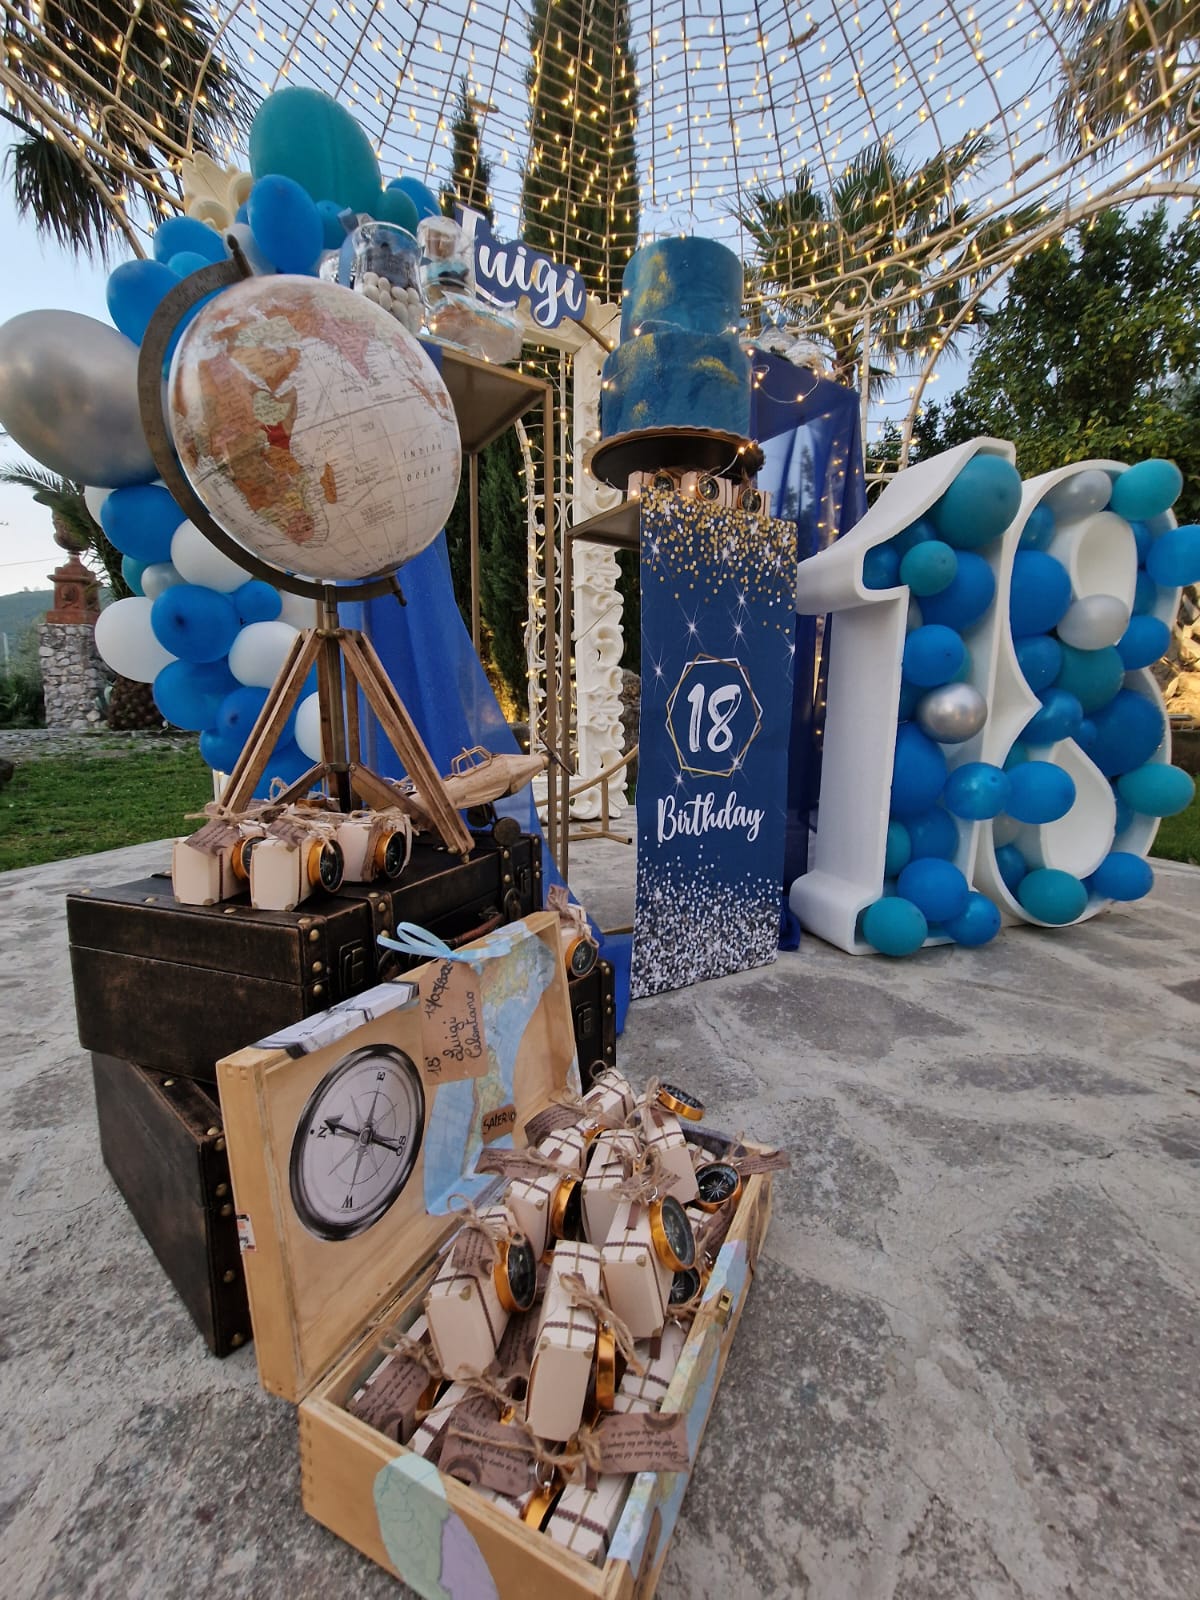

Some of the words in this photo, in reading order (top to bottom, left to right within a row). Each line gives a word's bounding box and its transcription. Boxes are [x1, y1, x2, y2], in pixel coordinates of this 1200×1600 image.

[403, 444, 442, 459] INDIAN
[406, 465, 442, 482] OCEAN
[788, 436, 1182, 957] 18
[687, 683, 741, 754] 18
[657, 791, 765, 843] Birthday
[442, 1016, 465, 1063] Luigi
[376, 1071, 386, 1081] E
[317, 1125, 329, 1138] N
[399, 1135, 407, 1145] S
[341, 1195, 353, 1208] W
